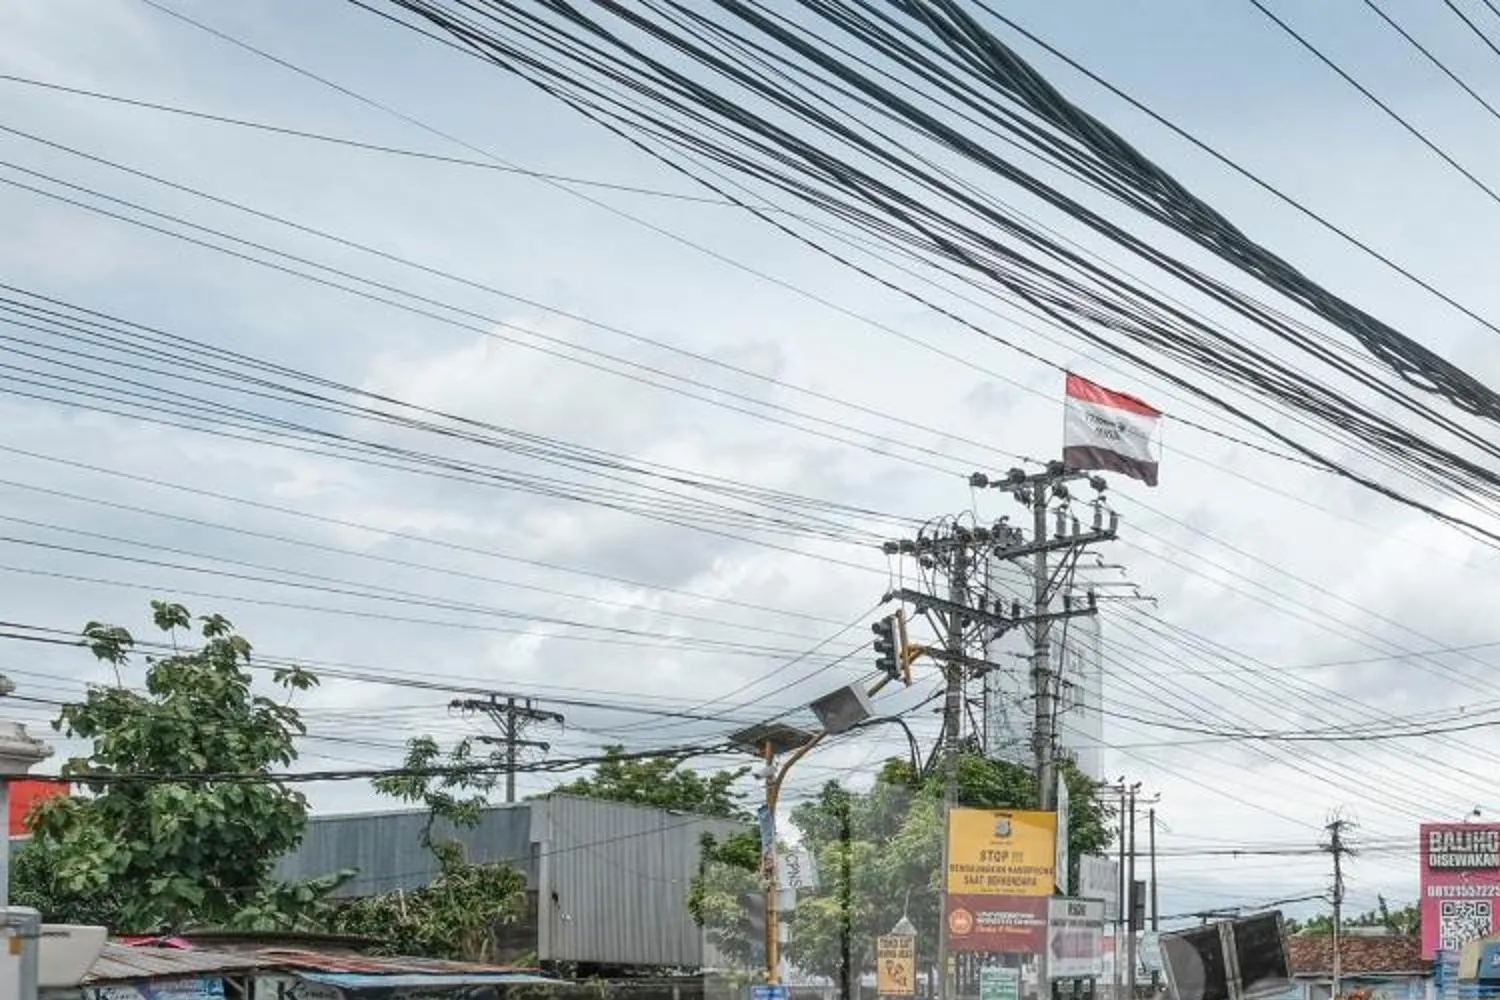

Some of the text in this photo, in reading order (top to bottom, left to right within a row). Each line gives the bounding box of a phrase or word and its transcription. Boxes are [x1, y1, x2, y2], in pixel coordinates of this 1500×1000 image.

[1429, 831, 1500, 853] BALIHO
[979, 850, 1009, 862] STOP
[1429, 853, 1500, 868] DISEWAKAN
